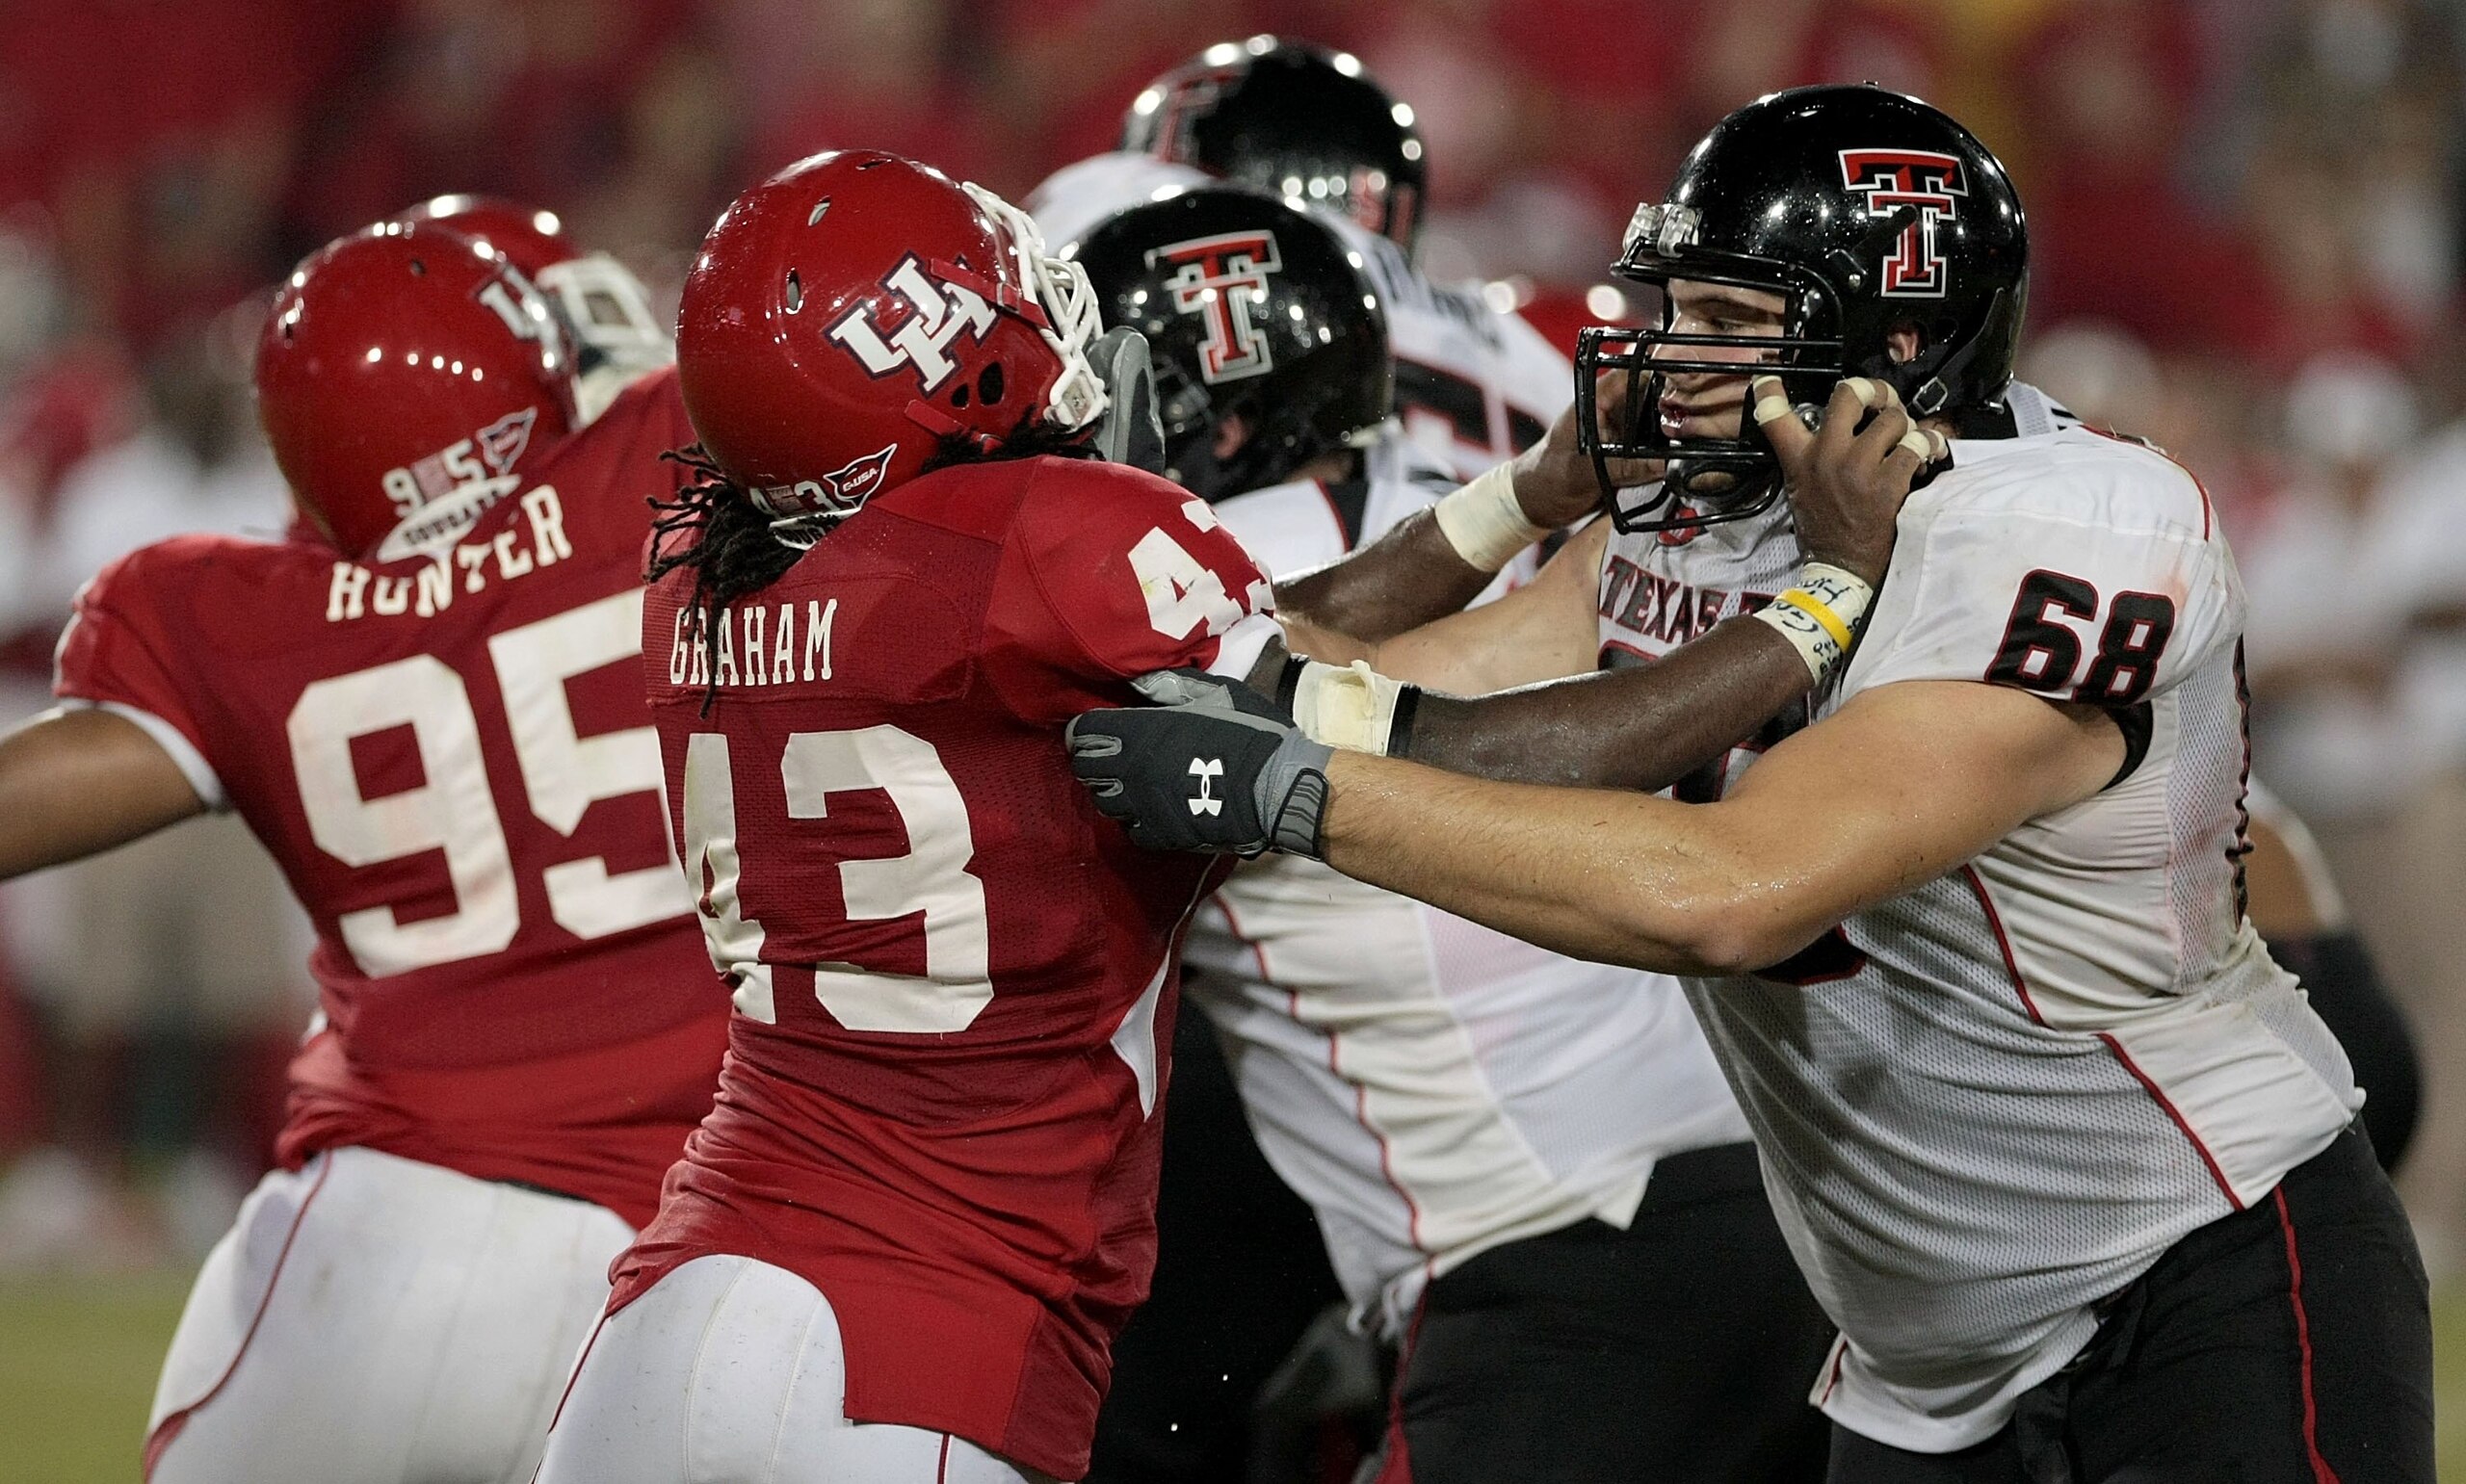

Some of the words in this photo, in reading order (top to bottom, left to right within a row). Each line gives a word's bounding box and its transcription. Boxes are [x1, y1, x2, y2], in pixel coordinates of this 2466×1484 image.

[327, 484, 571, 622] HUNTER
[1598, 554, 1728, 644] TEXAS
[669, 598, 839, 687] GRAHAM
[1983, 568, 2175, 706] 68
[285, 586, 700, 979] 95
